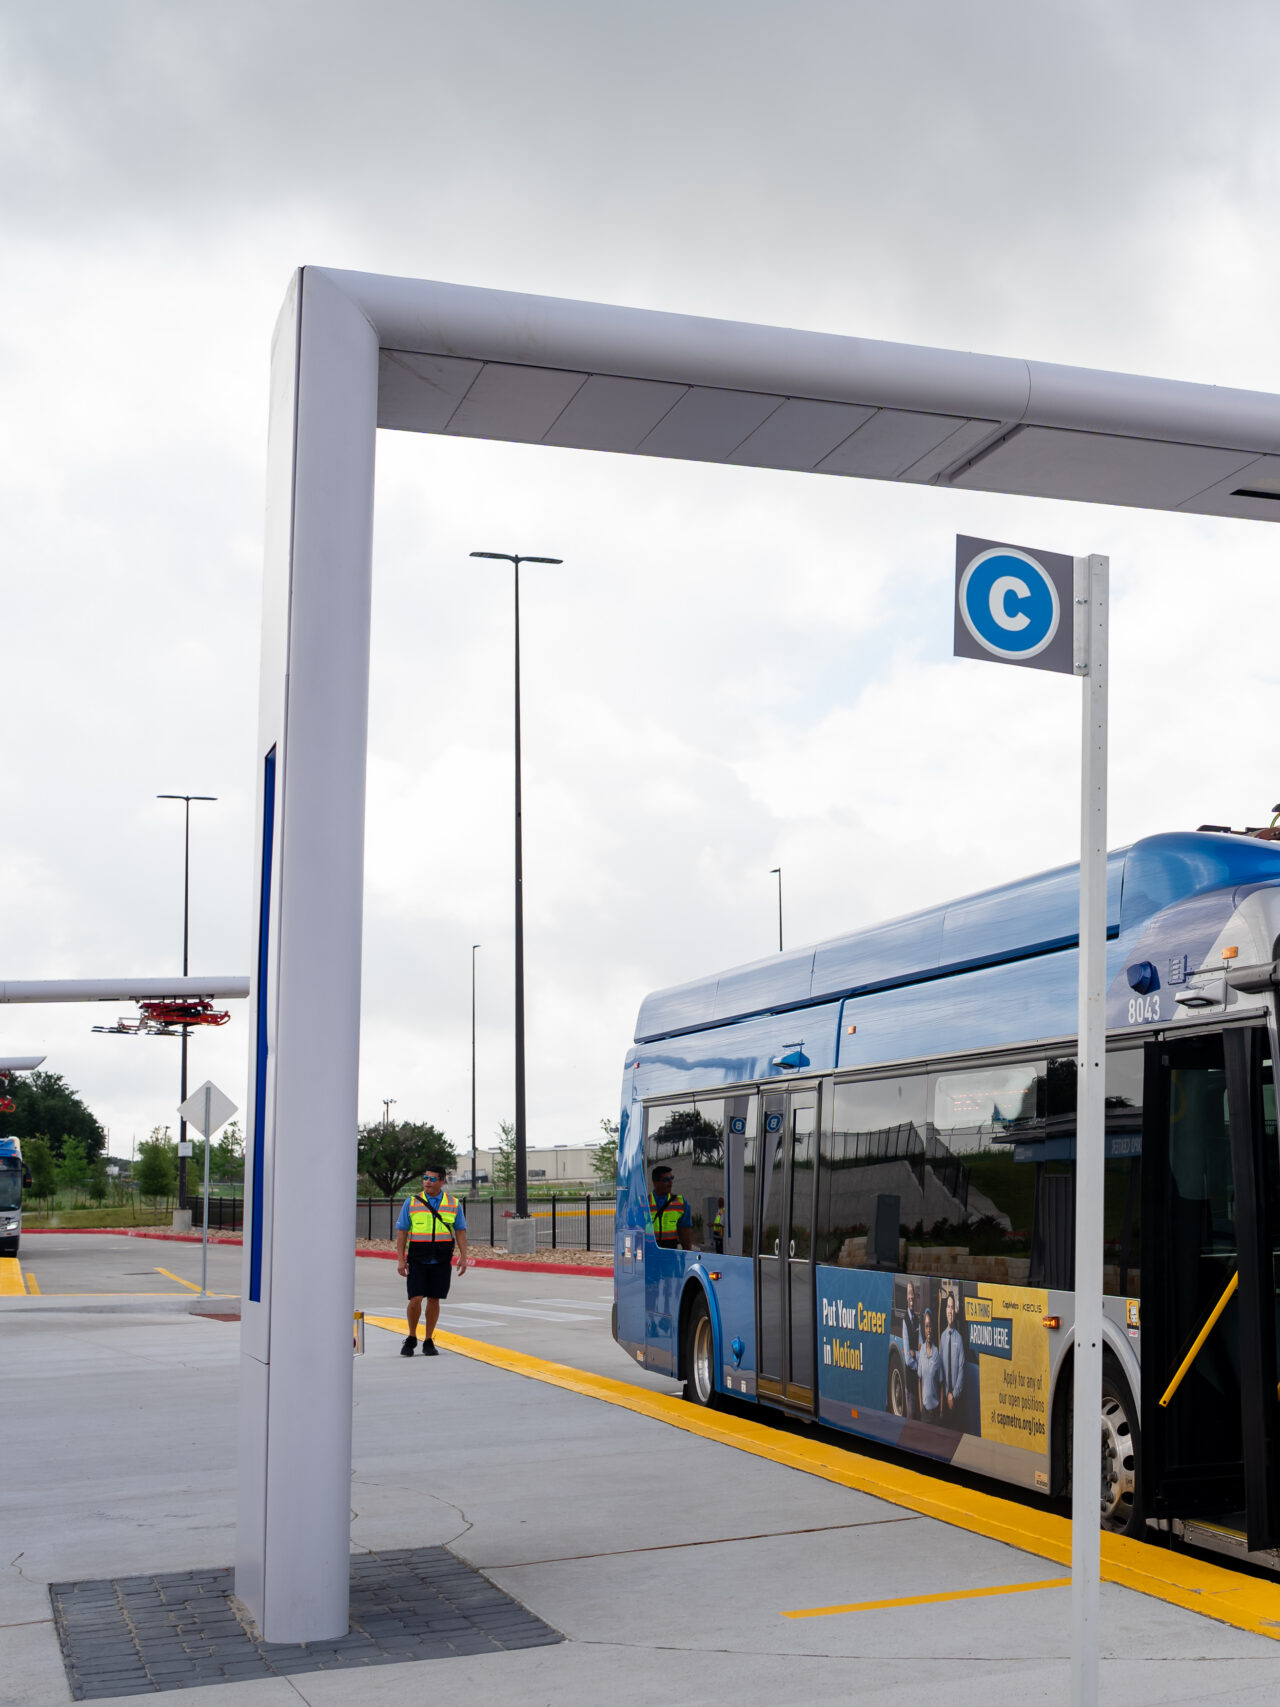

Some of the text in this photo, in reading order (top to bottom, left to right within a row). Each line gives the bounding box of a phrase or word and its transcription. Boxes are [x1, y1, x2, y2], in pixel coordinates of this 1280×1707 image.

[988, 575, 1032, 632] C
[1128, 995, 1160, 1024] 8043
[822, 1297, 887, 1334] Put Your Career
[970, 1324, 1010, 1349] AROUND HERE.
[824, 1336, 864, 1371] in Motion!
[1003, 1368, 1017, 1389] Apply
[1027, 1376, 1036, 1392] any
[999, 1392, 1045, 1413] our open positions
[997, 1413, 1046, 1436] capmetro.org/jobs
